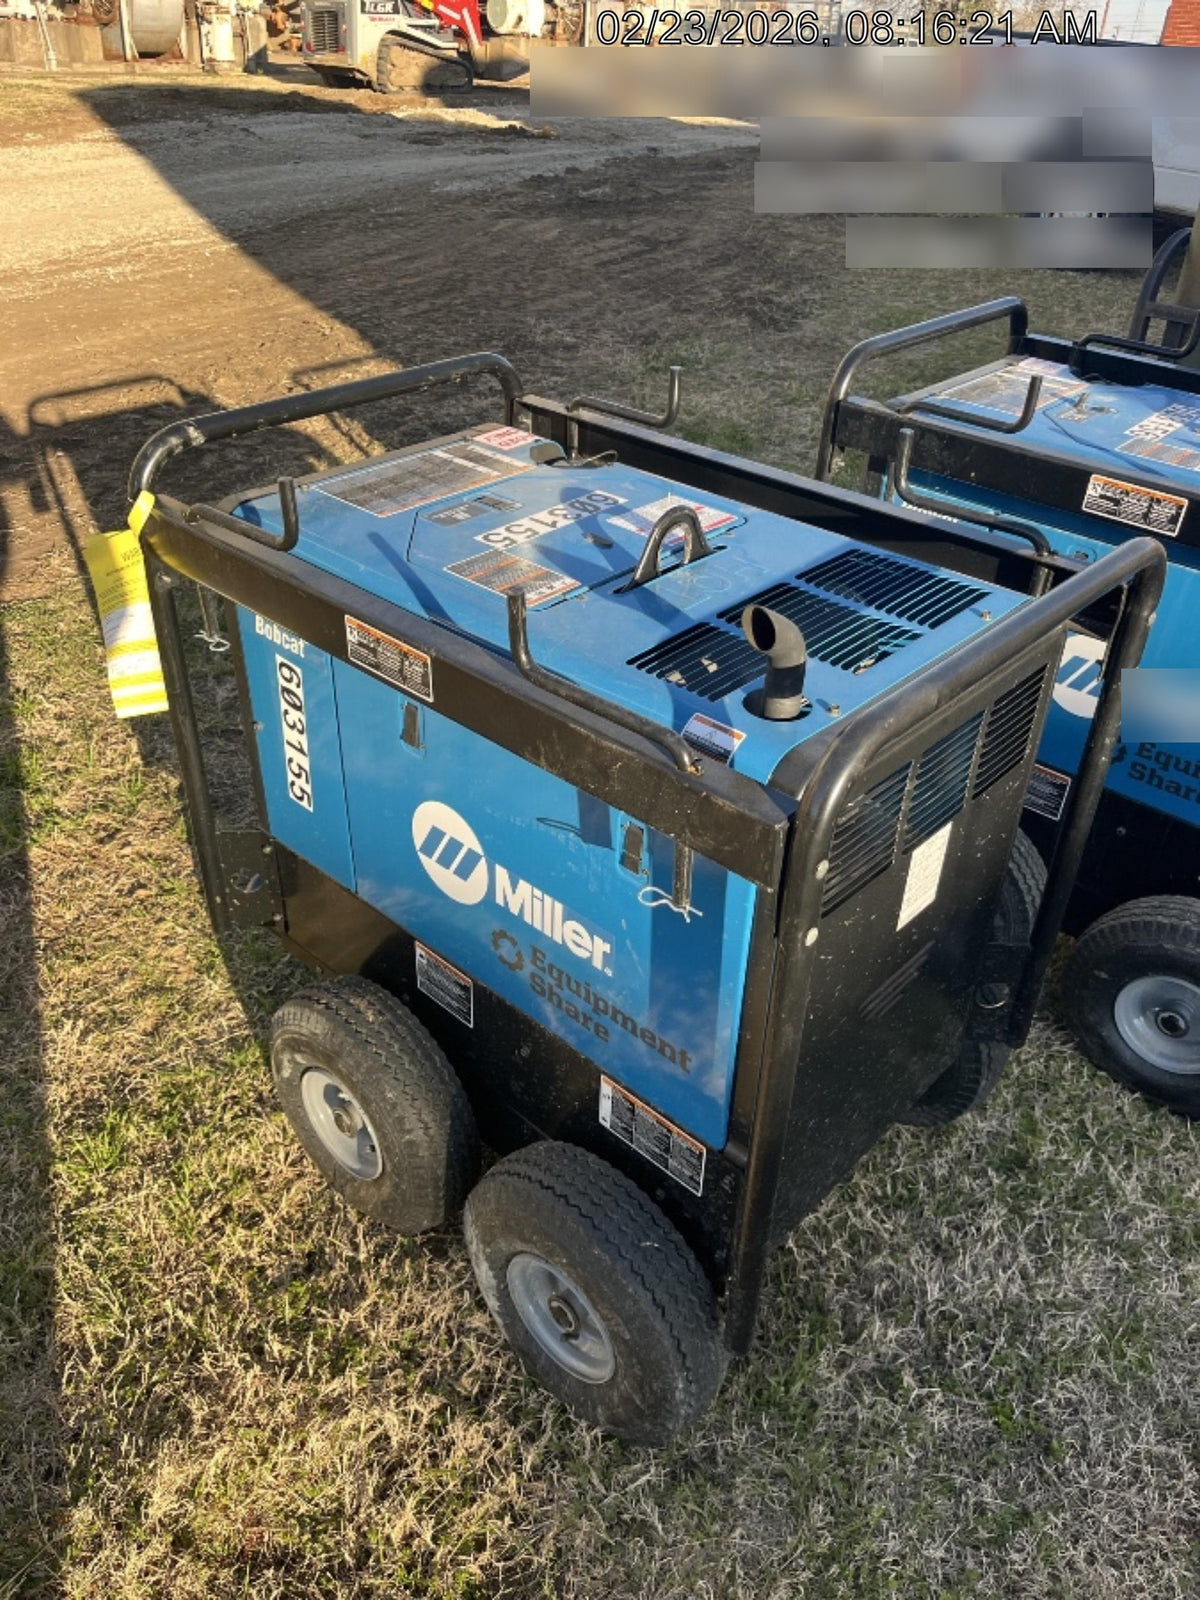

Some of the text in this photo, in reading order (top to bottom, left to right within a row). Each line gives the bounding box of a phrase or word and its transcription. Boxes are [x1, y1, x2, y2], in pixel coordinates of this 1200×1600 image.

[481, 493, 620, 549] 603155
[255, 615, 305, 658] Bobcat
[278, 661, 312, 808] 603155
[495, 863, 611, 972] Miller
[529, 972, 610, 1044] Share
[529, 943, 693, 1074] Equipment
